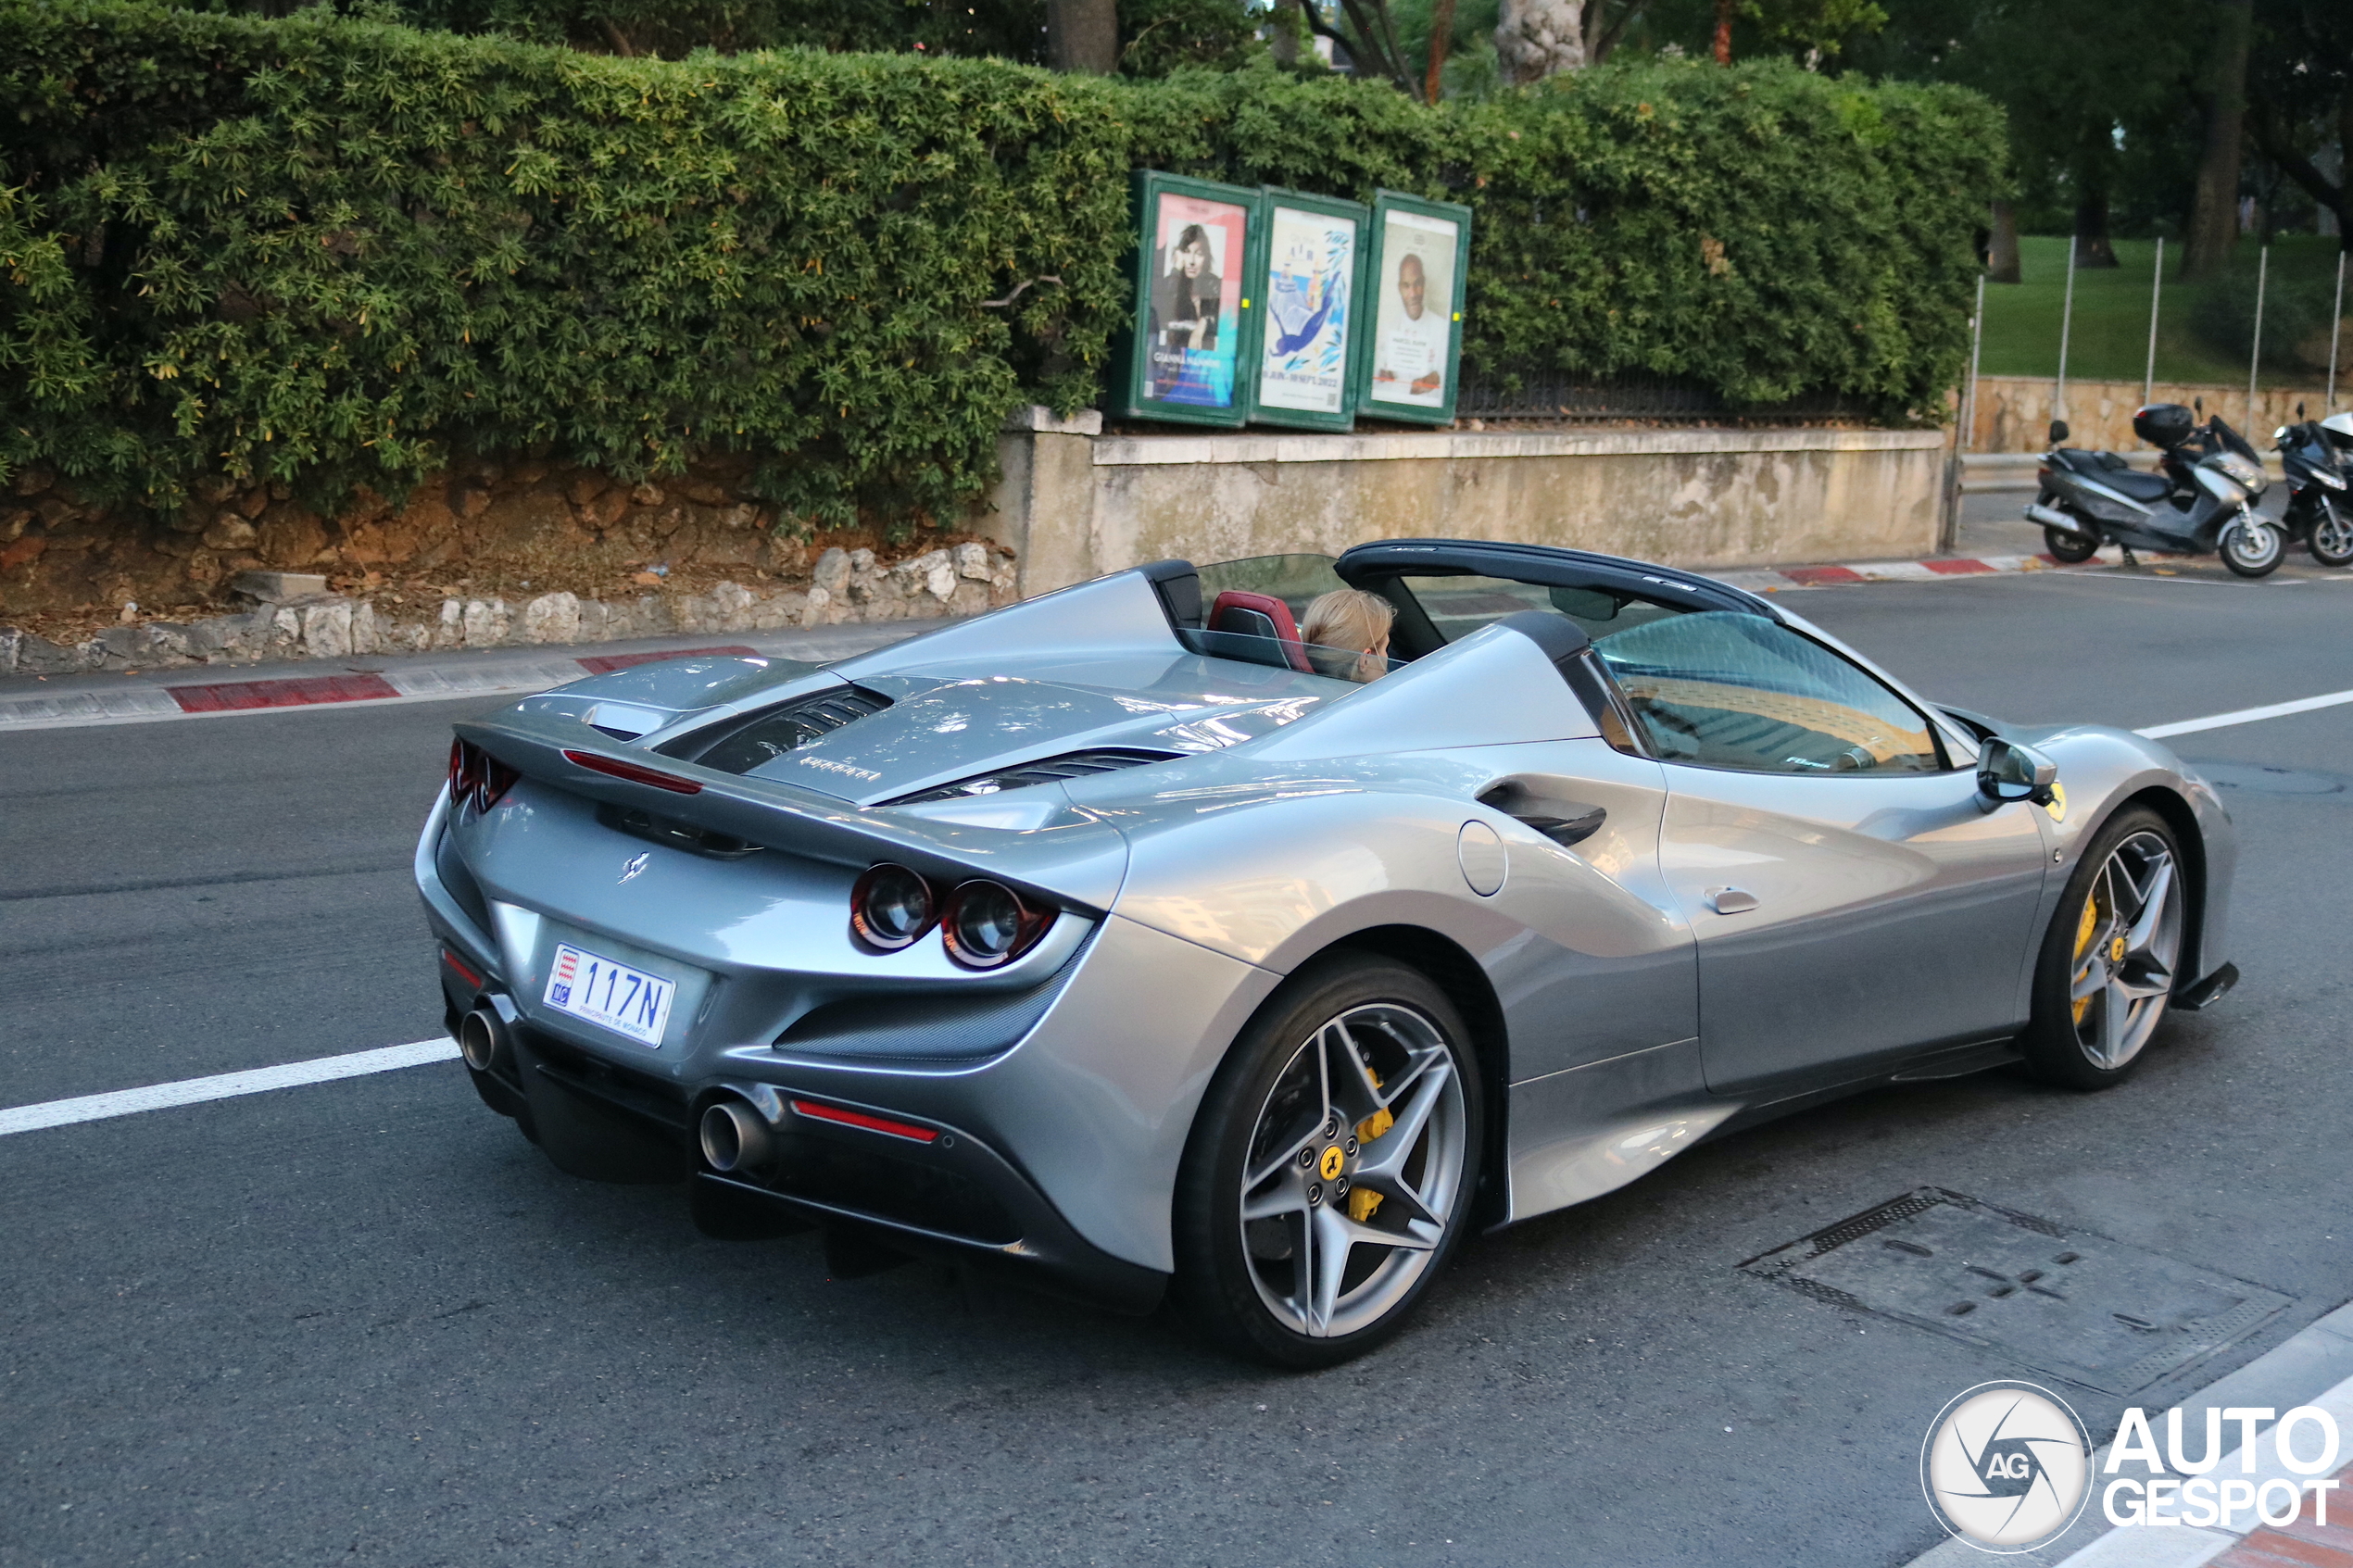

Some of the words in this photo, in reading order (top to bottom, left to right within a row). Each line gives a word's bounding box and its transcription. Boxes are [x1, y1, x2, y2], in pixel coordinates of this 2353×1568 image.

[1152, 352, 1186, 364] GIANNA
[553, 985, 569, 1003] MC
[585, 961, 663, 1028] 117N
[579, 1005, 613, 1024] PRINCIPAUTE
[613, 1018, 622, 1027] DE
[622, 1021, 648, 1036] MONACO
